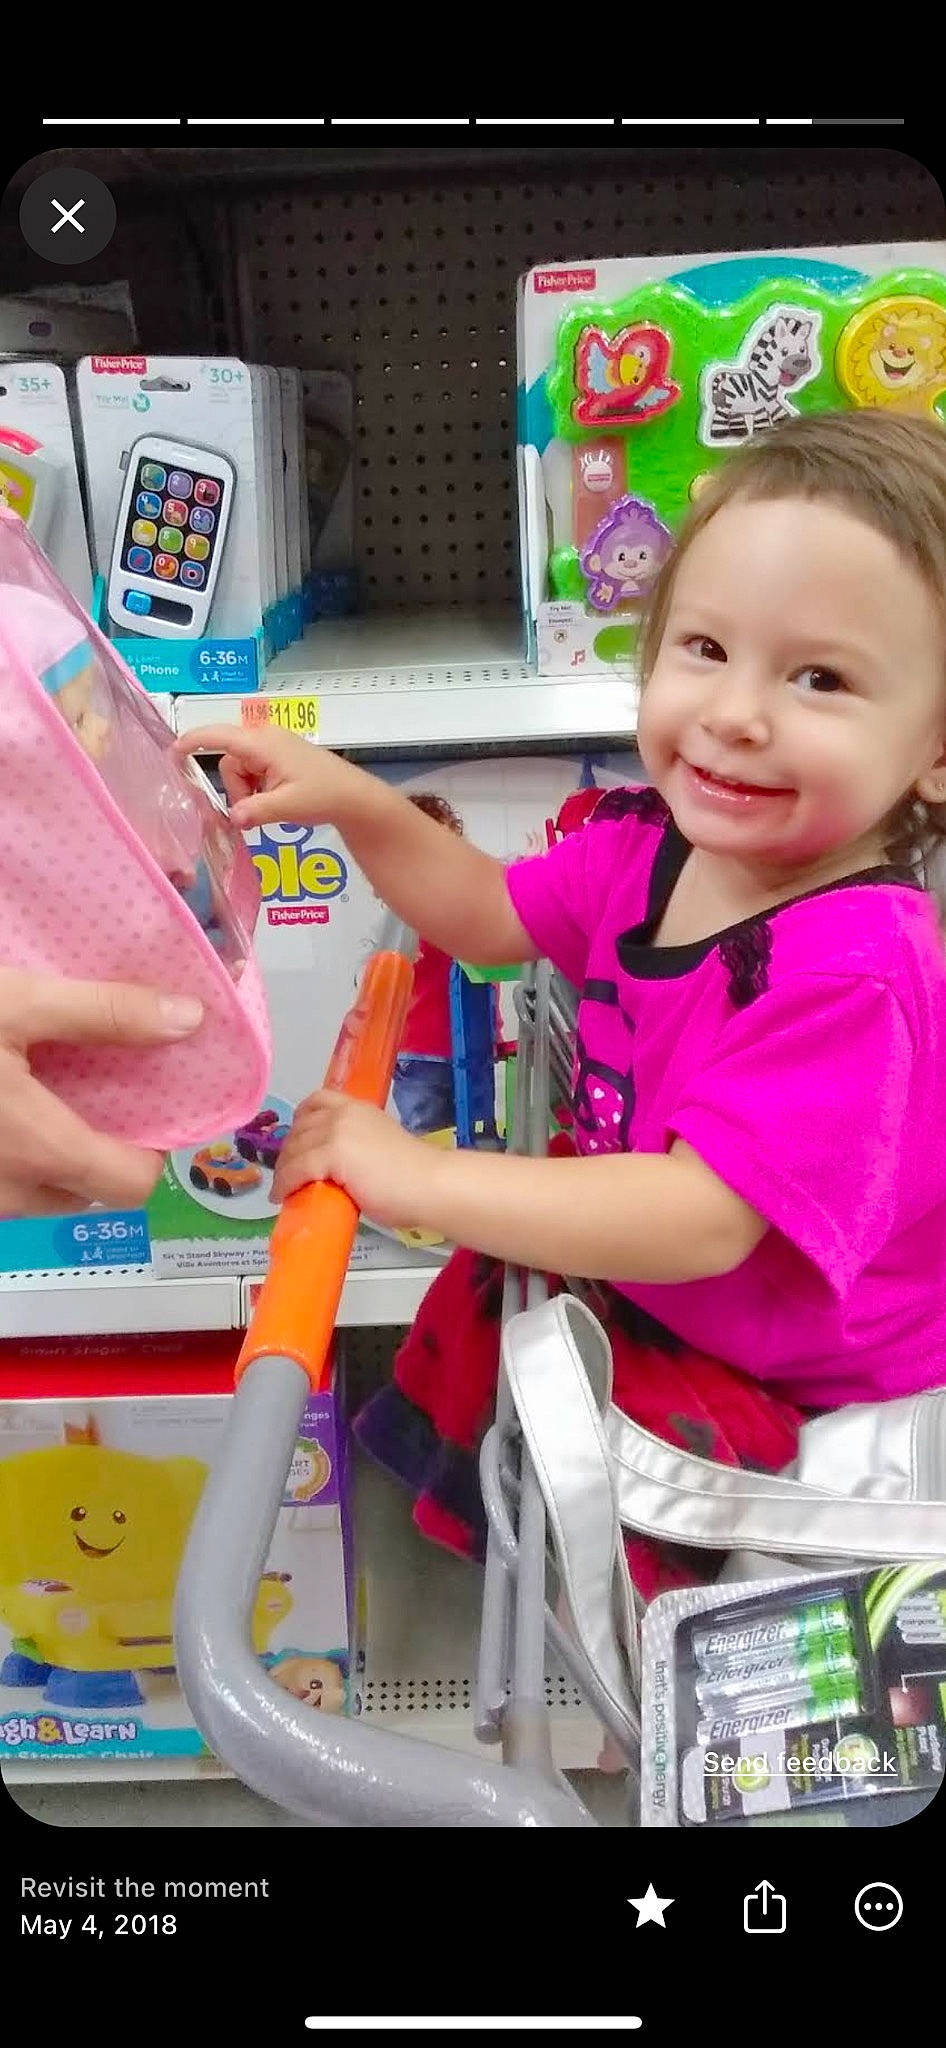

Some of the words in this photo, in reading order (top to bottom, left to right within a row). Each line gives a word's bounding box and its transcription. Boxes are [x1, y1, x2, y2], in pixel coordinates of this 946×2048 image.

[95, 358, 145, 370] Fisher-Price
[209, 367, 245, 384] 30+
[18, 377, 51, 393] 35+
[140, 665, 179, 675] Phone
[269, 702, 316, 729] $11.96
[271, 909, 326, 921] Fisher-Price
[705, 1623, 784, 1655] Energizer
[710, 1708, 793, 1740] Energizer
